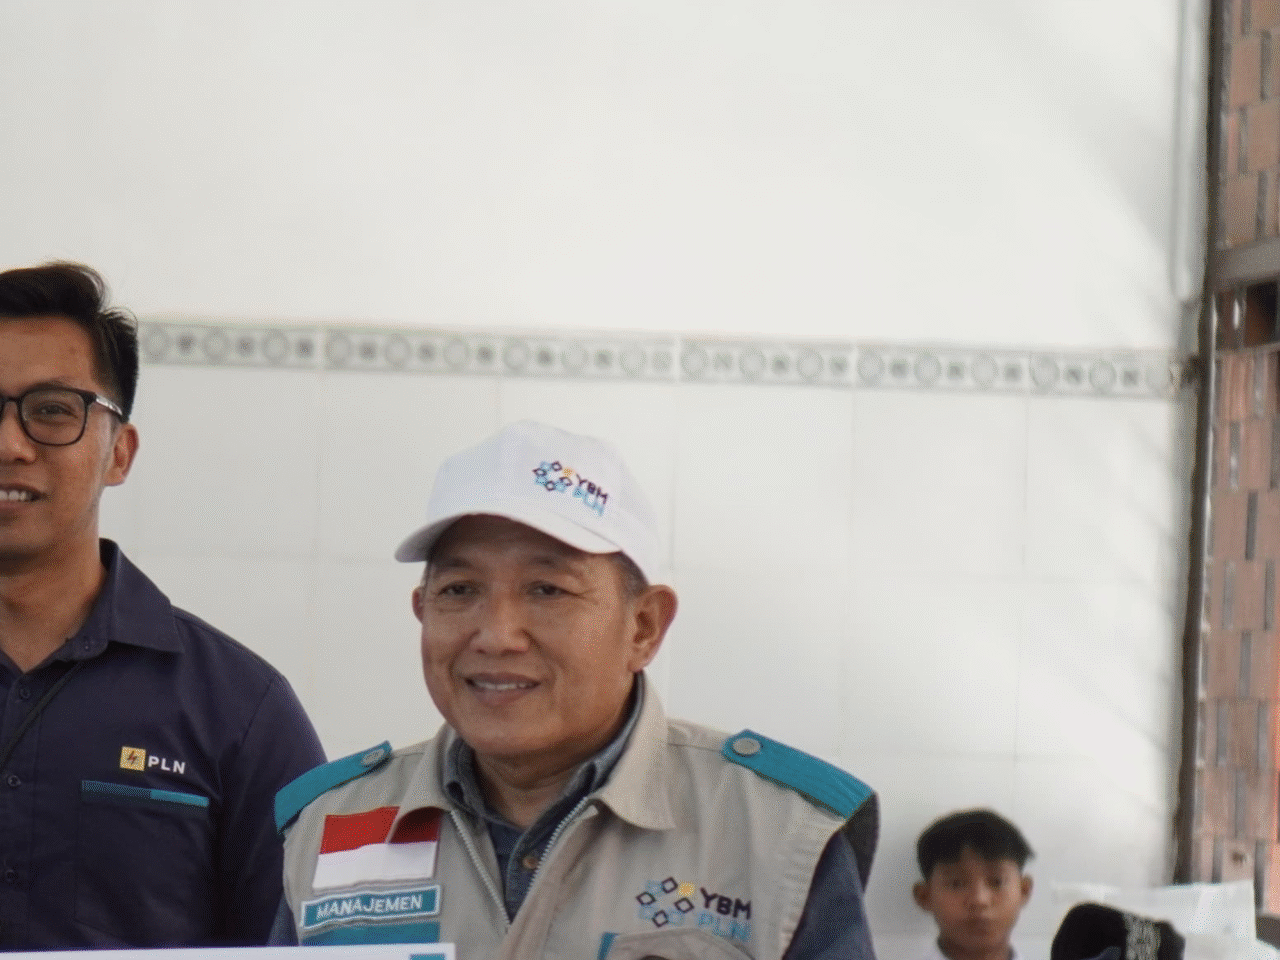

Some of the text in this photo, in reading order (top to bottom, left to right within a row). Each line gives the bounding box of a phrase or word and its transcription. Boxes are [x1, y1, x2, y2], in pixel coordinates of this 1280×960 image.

[147, 755, 186, 775] PLN
[316, 894, 424, 920] MANAJEMEN
[700, 887, 752, 920] YBM
